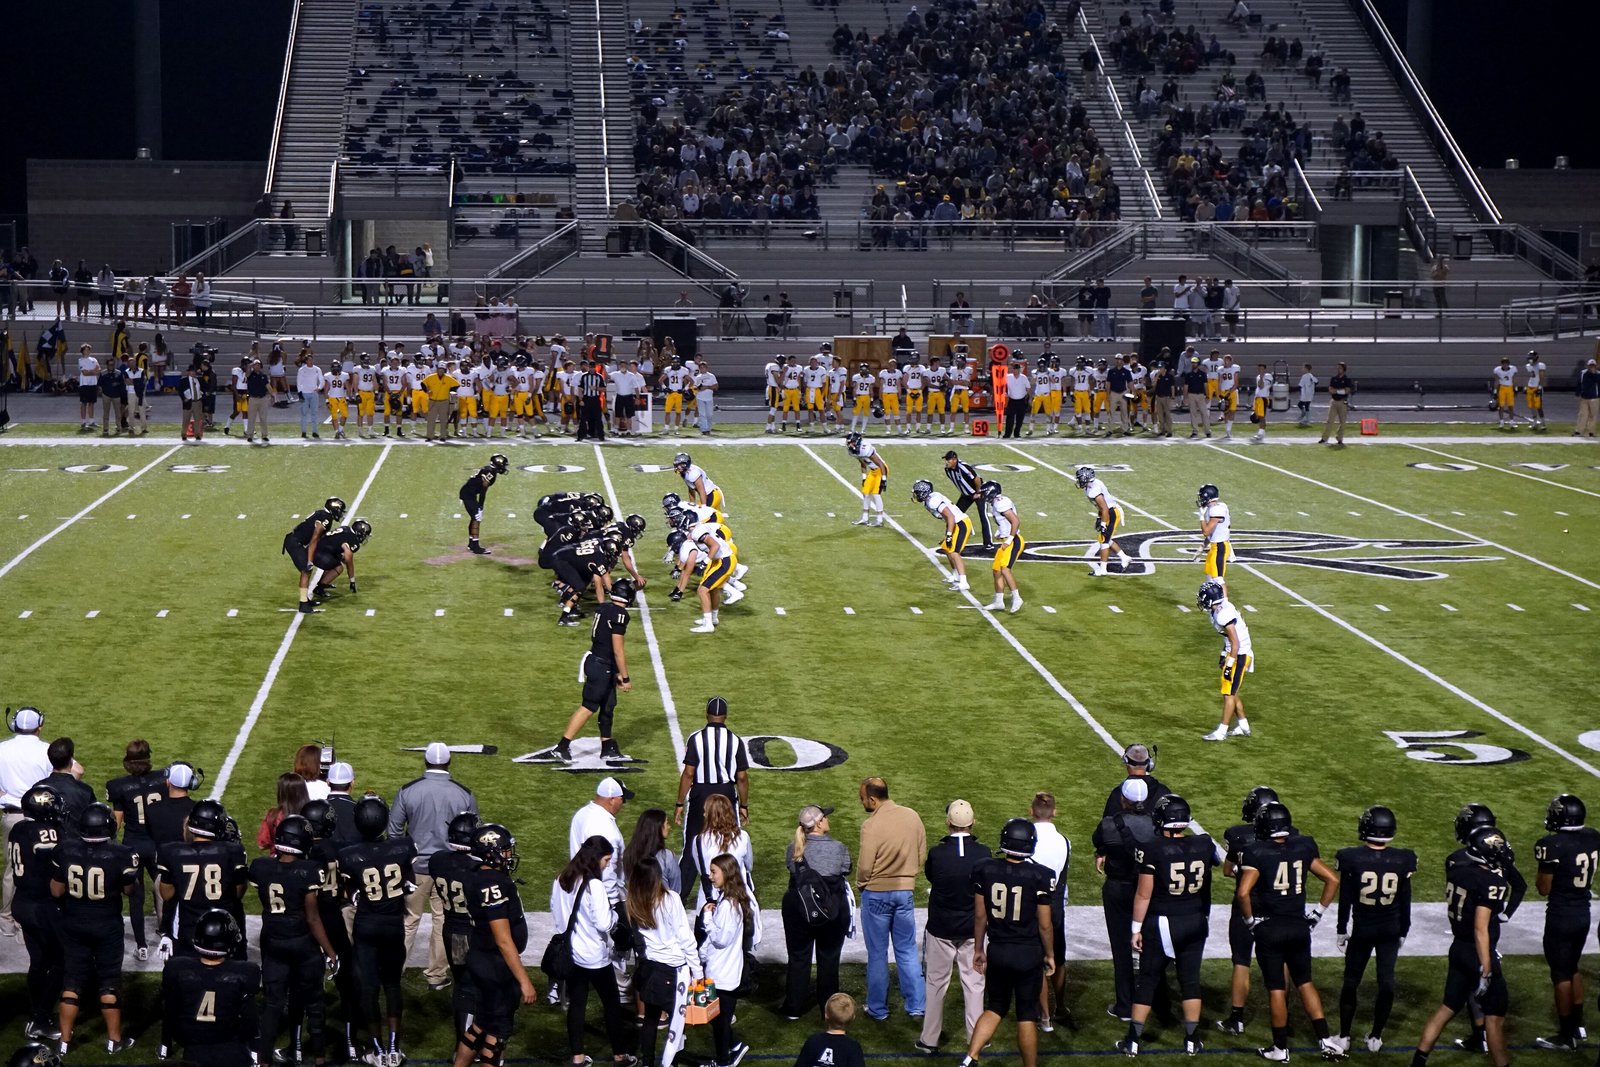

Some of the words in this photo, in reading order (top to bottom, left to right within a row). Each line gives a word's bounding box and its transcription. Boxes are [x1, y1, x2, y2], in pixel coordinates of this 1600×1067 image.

[332, 380, 343, 388] 99
[363, 374, 373, 383] 93
[389, 375, 399, 385] 97
[461, 378, 471, 388] 96
[671, 375, 679, 384] 31
[1077, 375, 1086, 384] 17
[975, 422, 988, 433] 50
[617, 613, 625, 624] 11
[738, 736, 849, 771] 0
[1381, 730, 1531, 766] 5
[39, 829, 58, 842] 20
[1535, 846, 1546, 860] 31
[68, 864, 105, 901] 60
[182, 864, 222, 900] 78
[362, 863, 404, 901] 82
[1168, 860, 1205, 895] 53
[1273, 860, 1303, 895] 41
[480, 885, 502, 903] 75
[1359, 871, 1398, 906] 29
[1488, 886, 1506, 900] 27
[269, 883, 286, 914] 6
[991, 882, 1023, 921] 91
[196, 991, 216, 1022] 4
[817, 1047, 835, 1065] A
